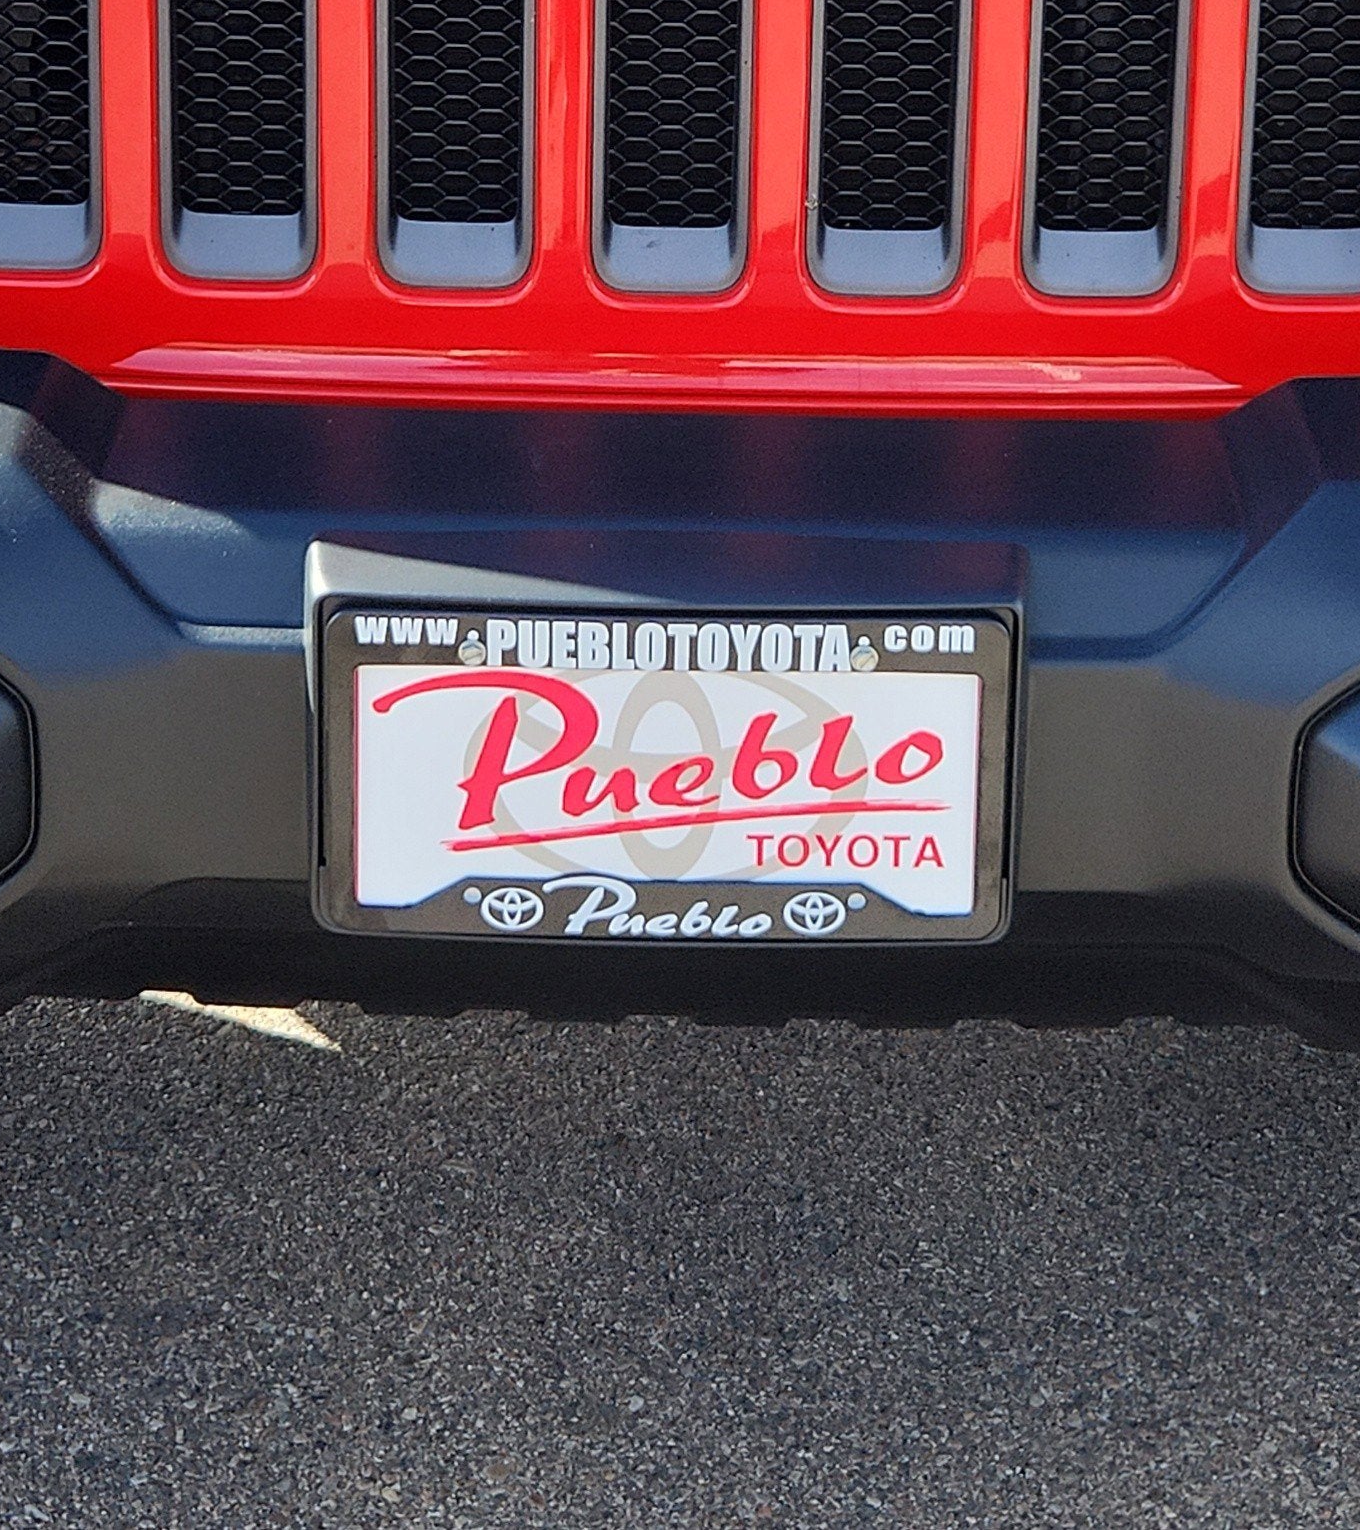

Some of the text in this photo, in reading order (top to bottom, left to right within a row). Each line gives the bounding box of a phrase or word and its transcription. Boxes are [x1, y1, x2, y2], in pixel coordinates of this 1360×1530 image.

[372, 670, 945, 830] Pueblo
[745, 833, 946, 868] TOYOTA
[541, 874, 773, 938] Pueblo
